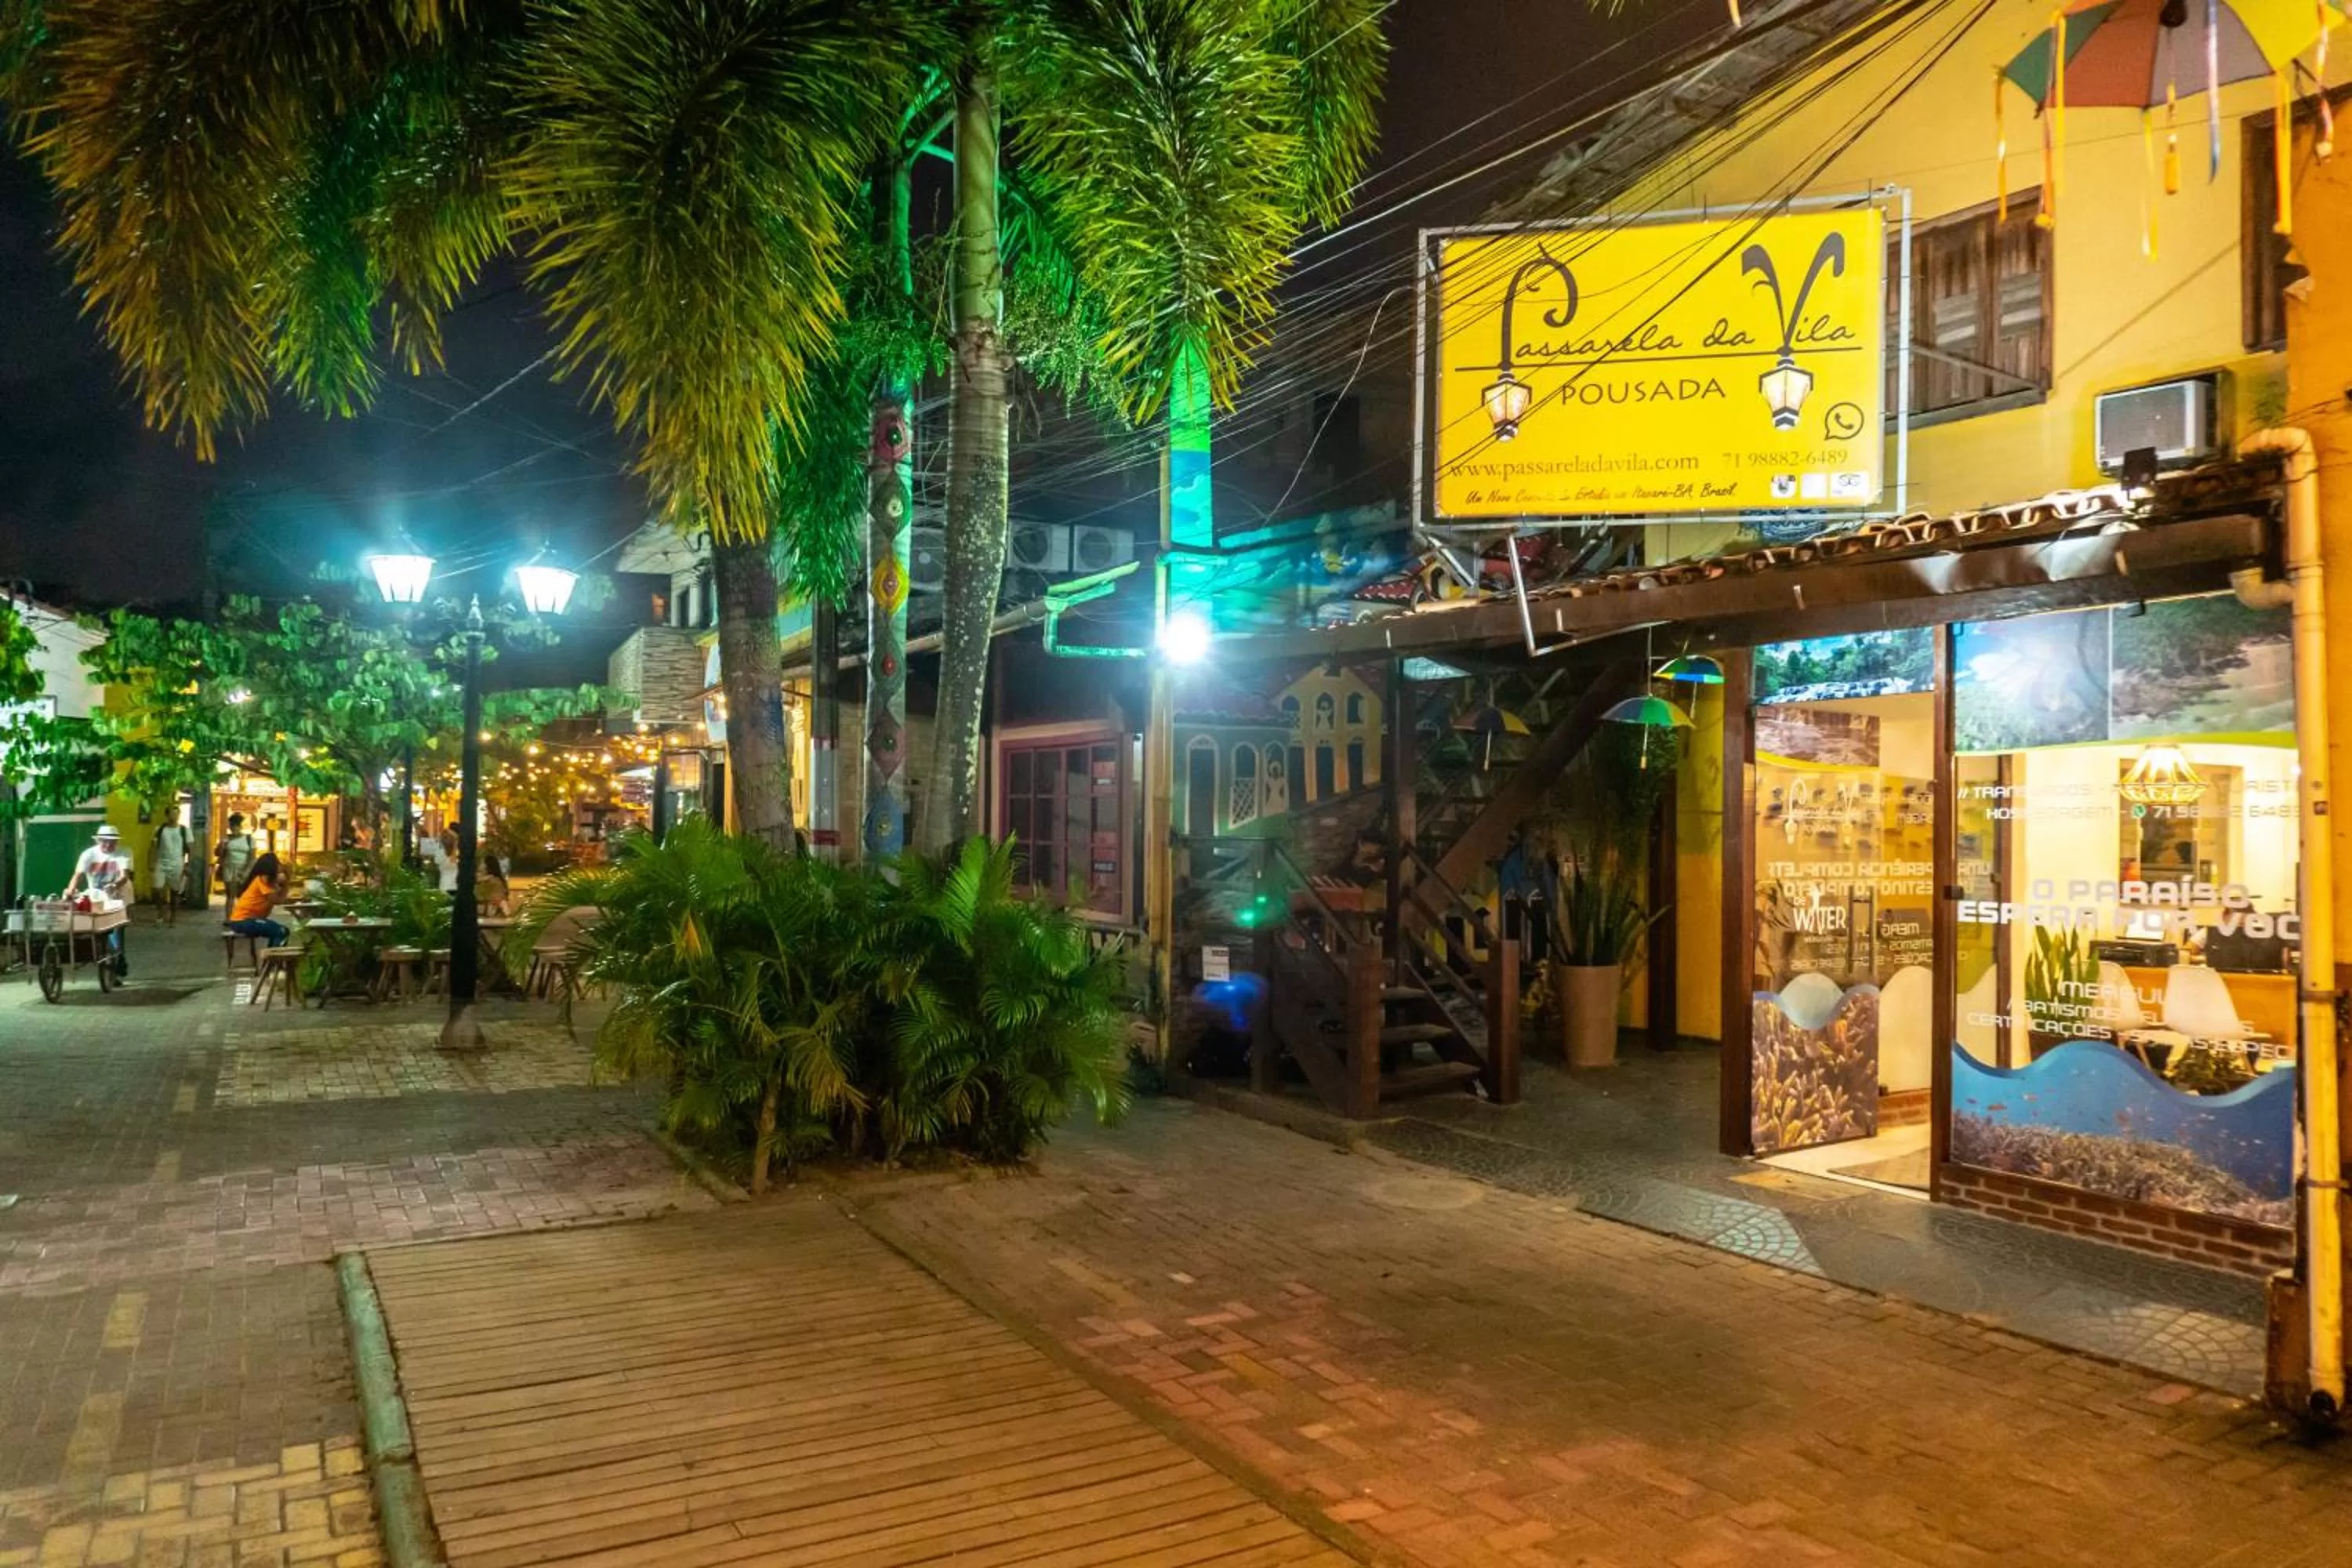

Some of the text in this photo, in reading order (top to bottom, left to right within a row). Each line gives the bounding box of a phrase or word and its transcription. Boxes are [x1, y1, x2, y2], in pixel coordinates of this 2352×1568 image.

[1501, 231, 1856, 371] Passarela da Vila
[1561, 378, 1726, 405] POUSADA
[1450, 452, 1700, 483] www.passareladavila.com
[1722, 449, 1849, 468] 71 98882-6489
[2068, 875, 2251, 909] PARAÍSO
[1957, 901, 2098, 929] ESPERA
[2215, 913, 2301, 940] VOC
